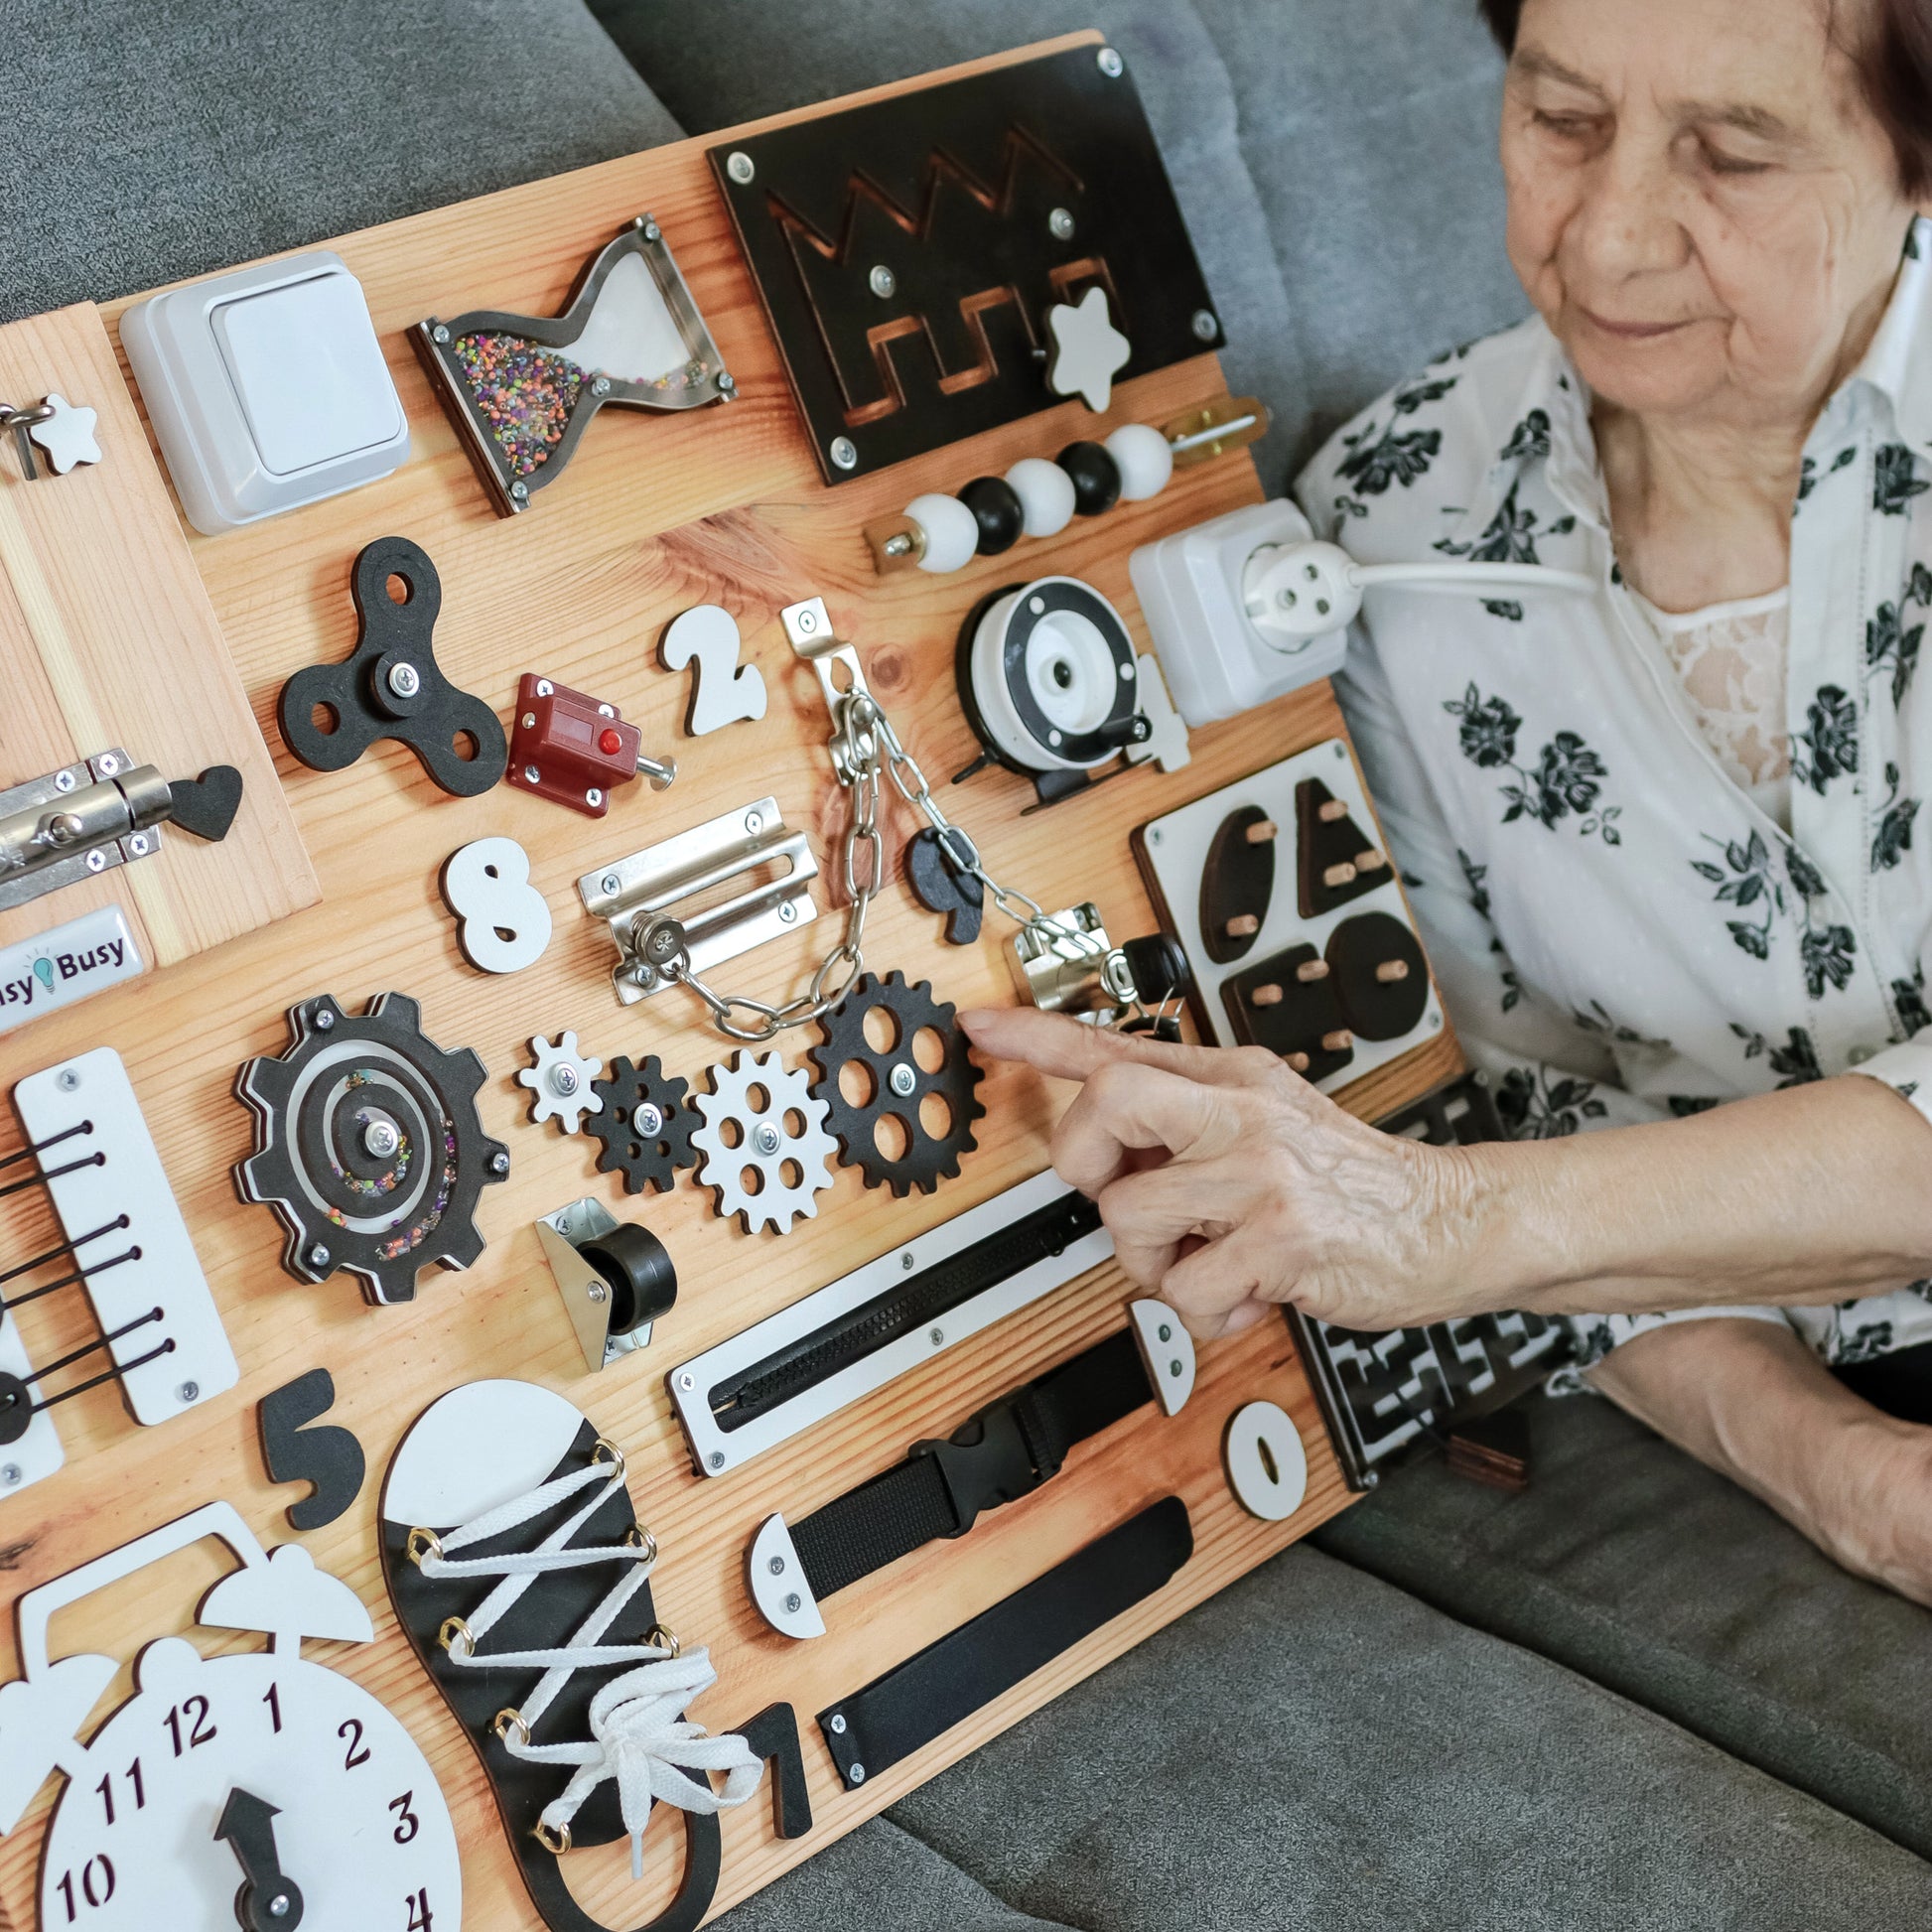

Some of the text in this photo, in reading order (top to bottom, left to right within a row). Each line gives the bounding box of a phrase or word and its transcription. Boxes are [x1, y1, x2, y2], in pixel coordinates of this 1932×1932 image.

[656, 604, 768, 737] 2
[438, 836, 553, 974] 8
[56, 937, 124, 981] Busy
[255, 1367, 366, 1532] 5
[163, 1695, 217, 1758] 12
[262, 1681, 282, 1734] 1
[338, 1718, 372, 1772] 2
[95, 1756, 146, 1827] 11
[388, 1789, 420, 1845] 3
[56, 1854, 116, 1924] 10
[405, 1886, 434, 1932] 4
